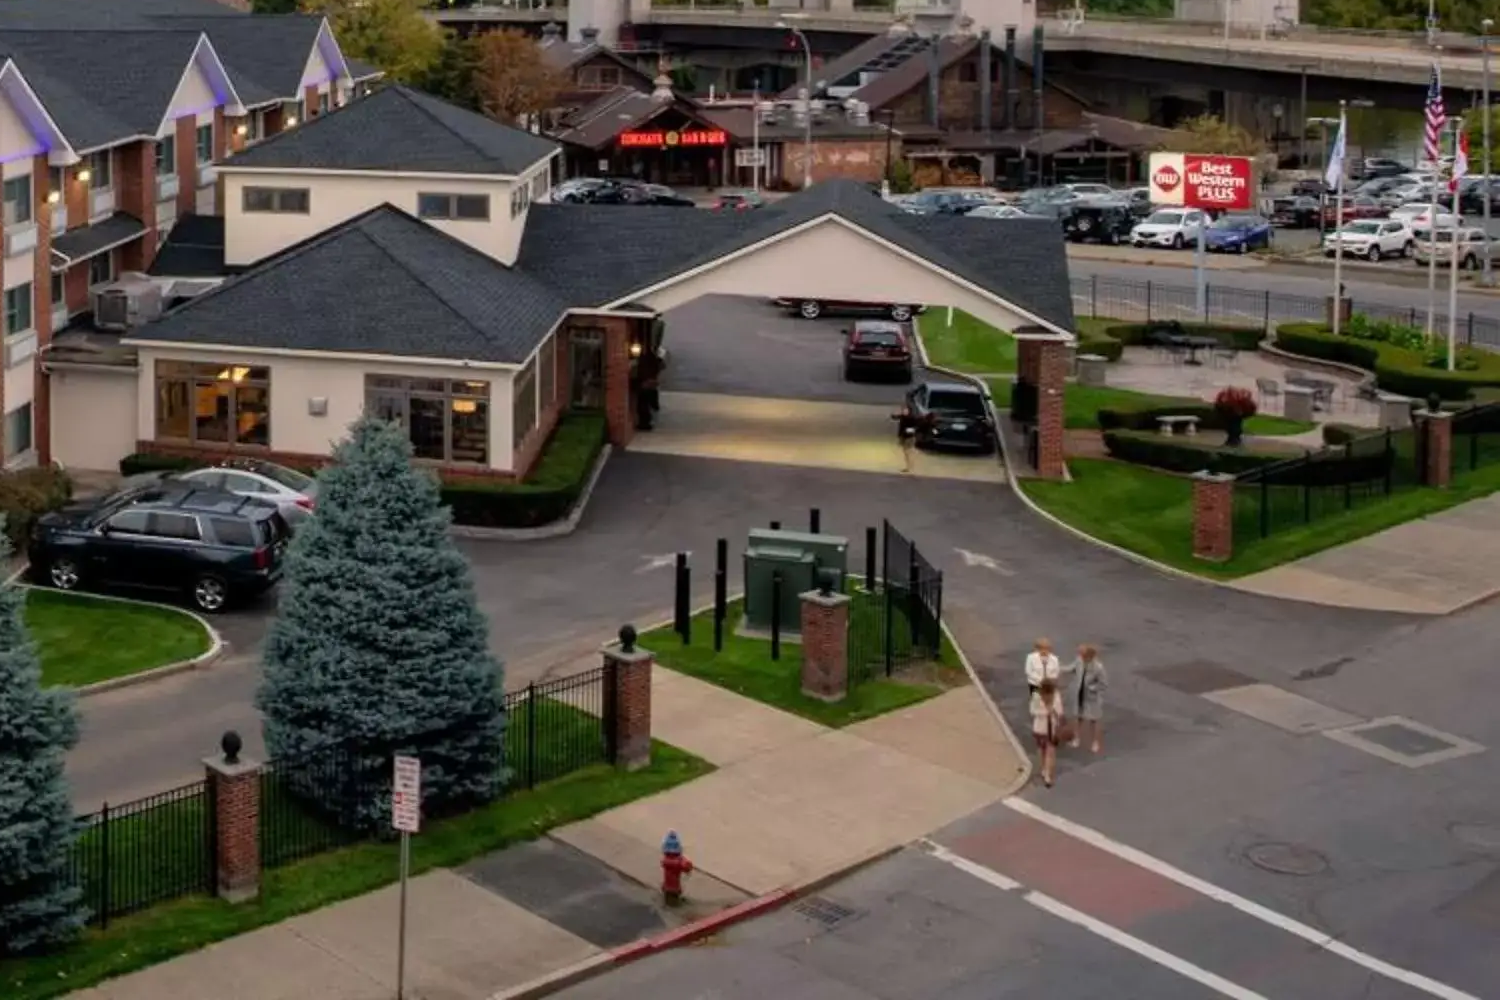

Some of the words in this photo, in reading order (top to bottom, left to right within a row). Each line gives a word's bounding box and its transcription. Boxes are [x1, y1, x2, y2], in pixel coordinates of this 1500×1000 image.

[1201, 161, 1233, 175] Best
[1188, 172, 1245, 187] Western
[1197, 186, 1236, 199] PLUS
